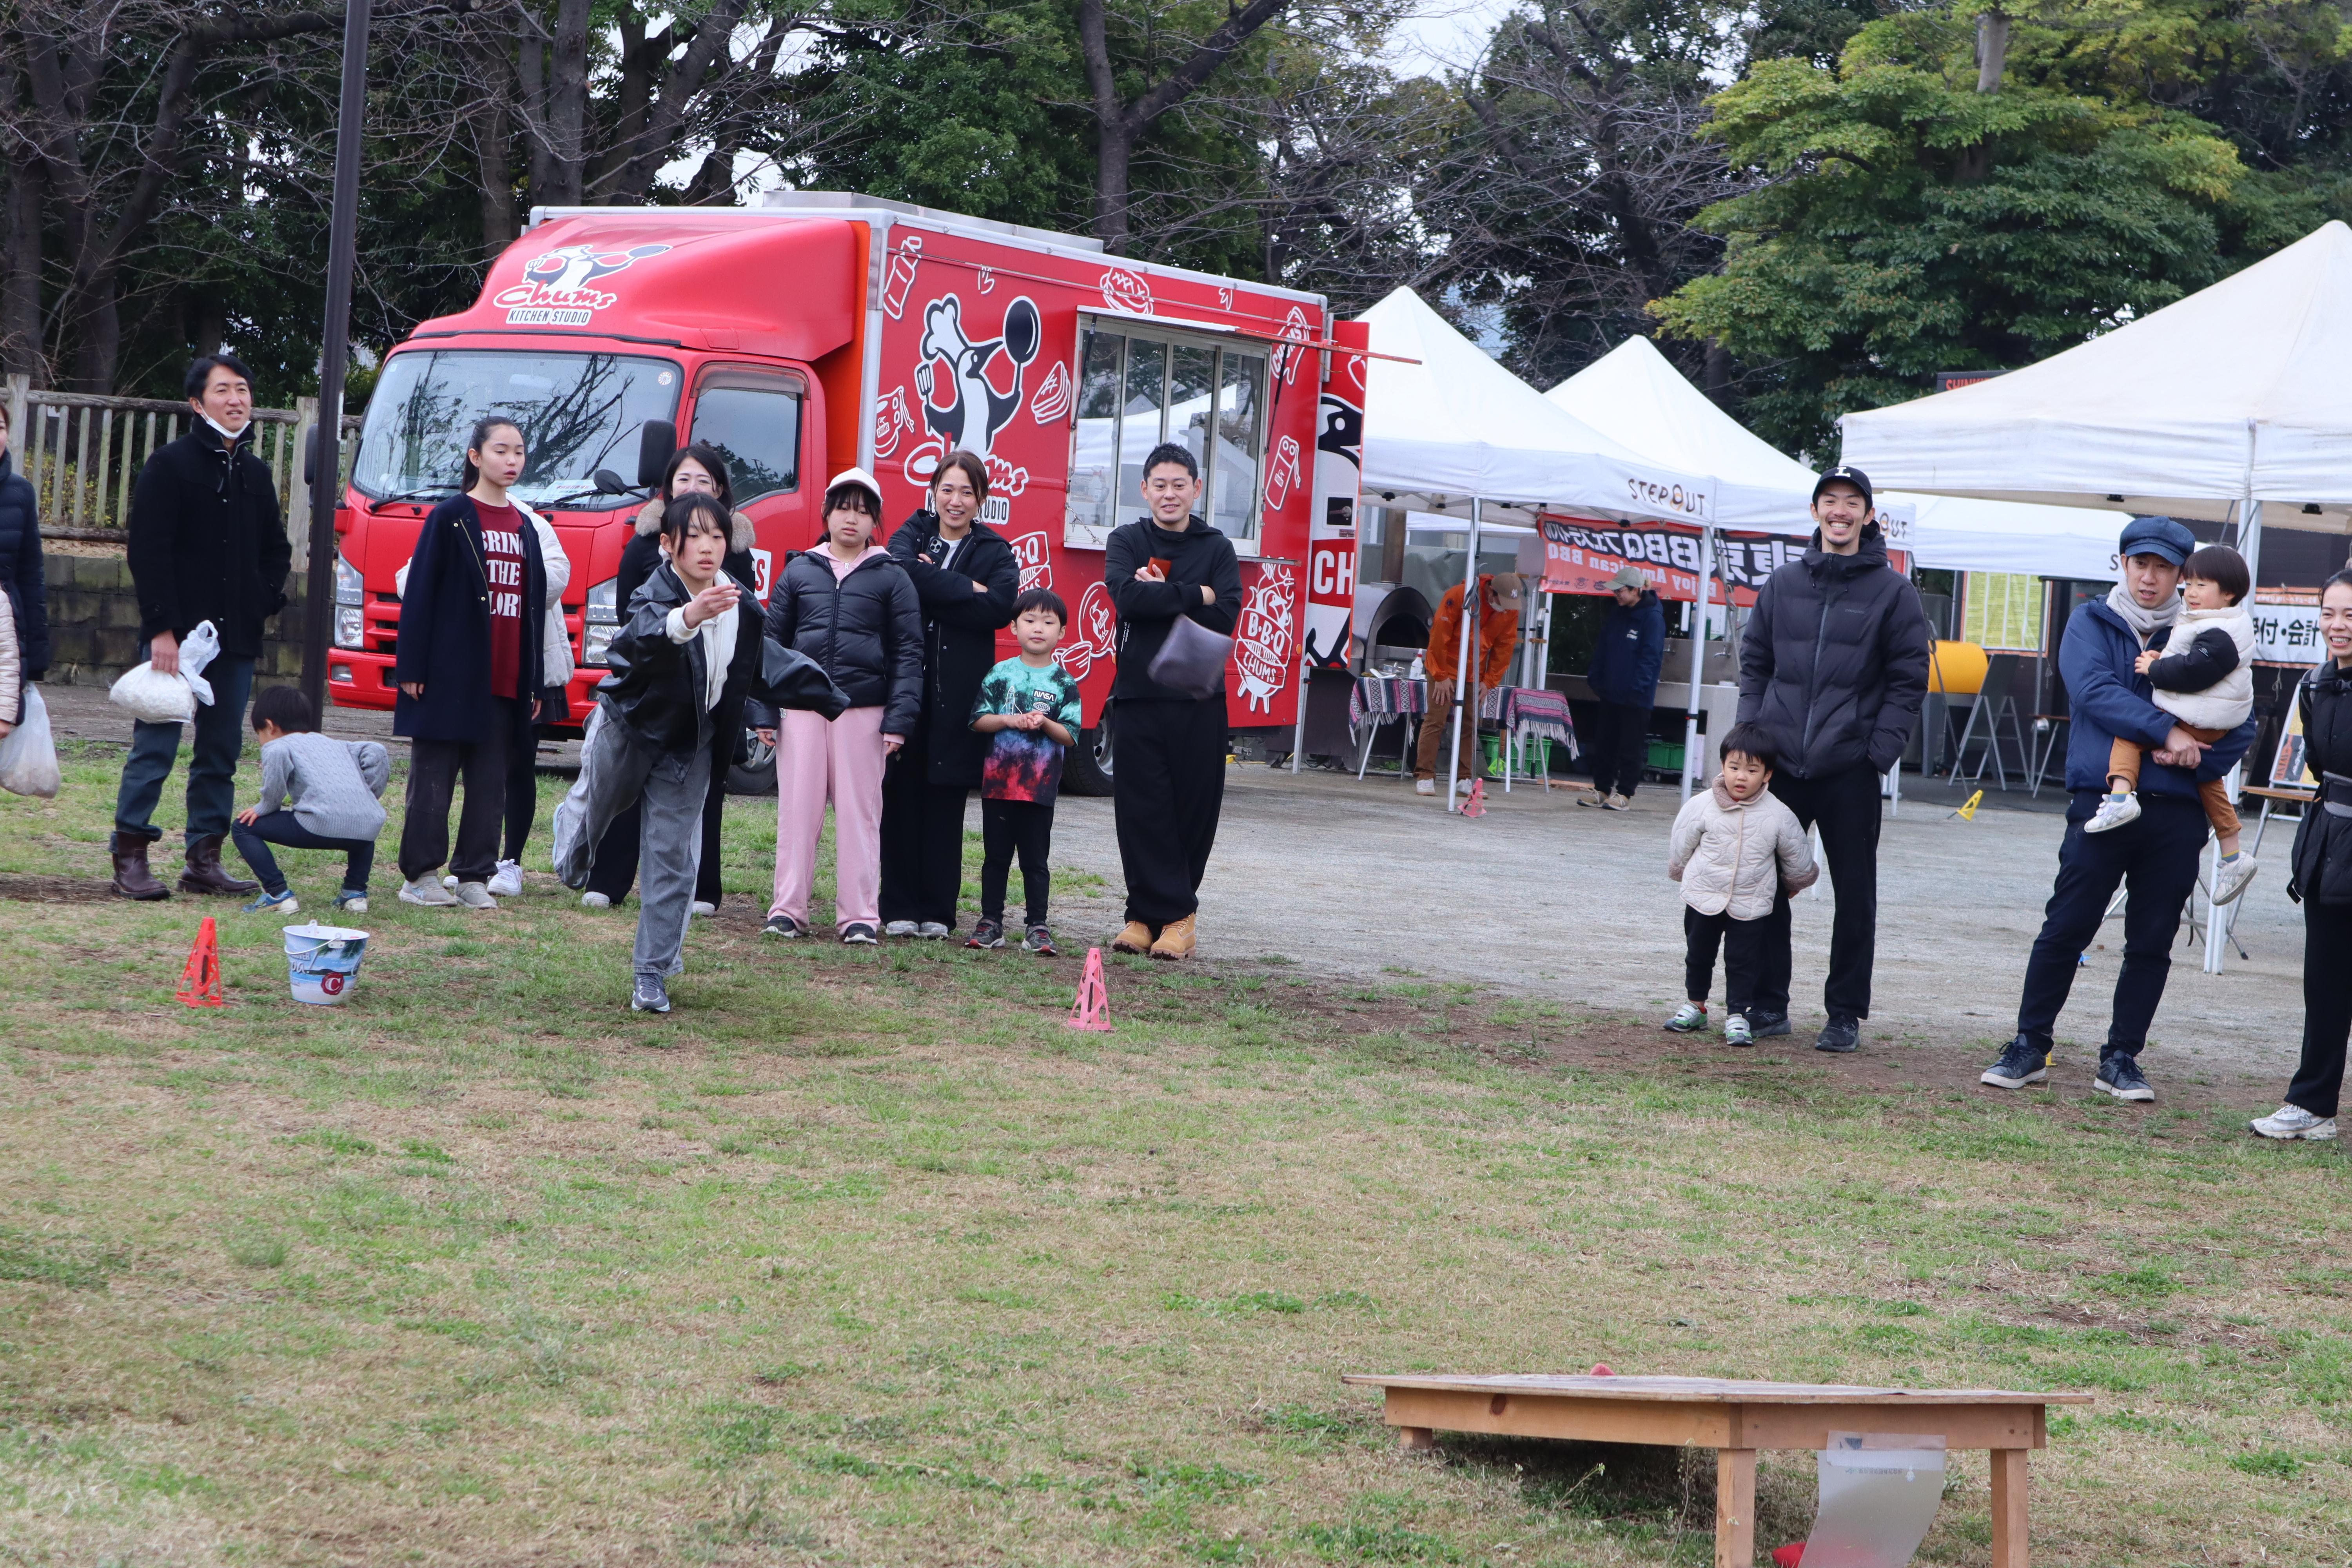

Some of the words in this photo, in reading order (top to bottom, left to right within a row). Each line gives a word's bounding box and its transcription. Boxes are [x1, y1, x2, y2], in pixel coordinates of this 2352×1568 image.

[495, 279, 615, 308] Chums
[508, 310, 550, 321] KITCHEN
[552, 311, 589, 323] STUDIO
[1835, 467, 1850, 477] L
[486, 559, 521, 586] THE
[1098, 610, 1109, 627] CHUMS
[1243, 651, 1276, 683] CHUMS
[1034, 691, 1054, 702] NASA
